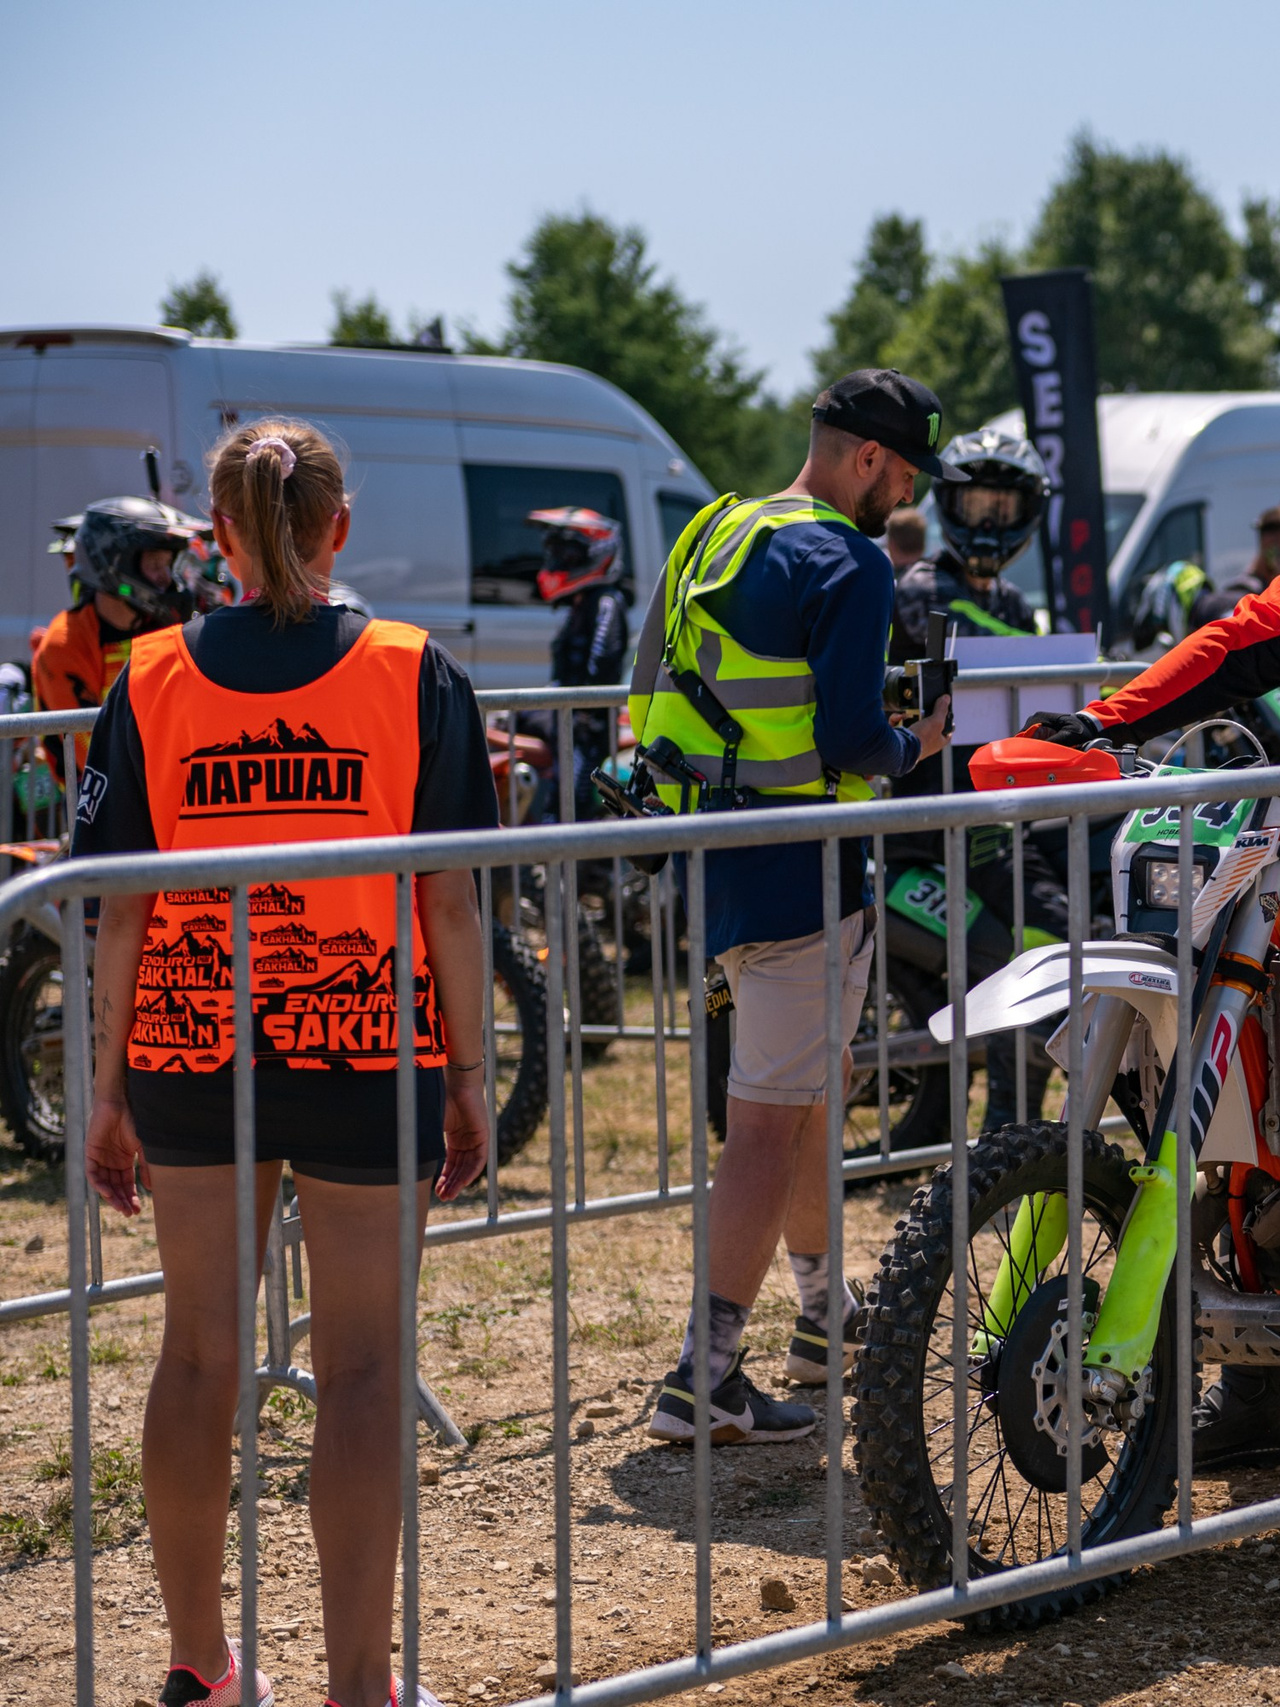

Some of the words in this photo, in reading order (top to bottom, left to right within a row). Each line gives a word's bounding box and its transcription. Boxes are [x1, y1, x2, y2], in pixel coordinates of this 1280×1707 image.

[181, 757, 363, 807] МАРШАЛ
[1234, 836, 1269, 849] KTM
[705, 988, 731, 1014] EDIA
